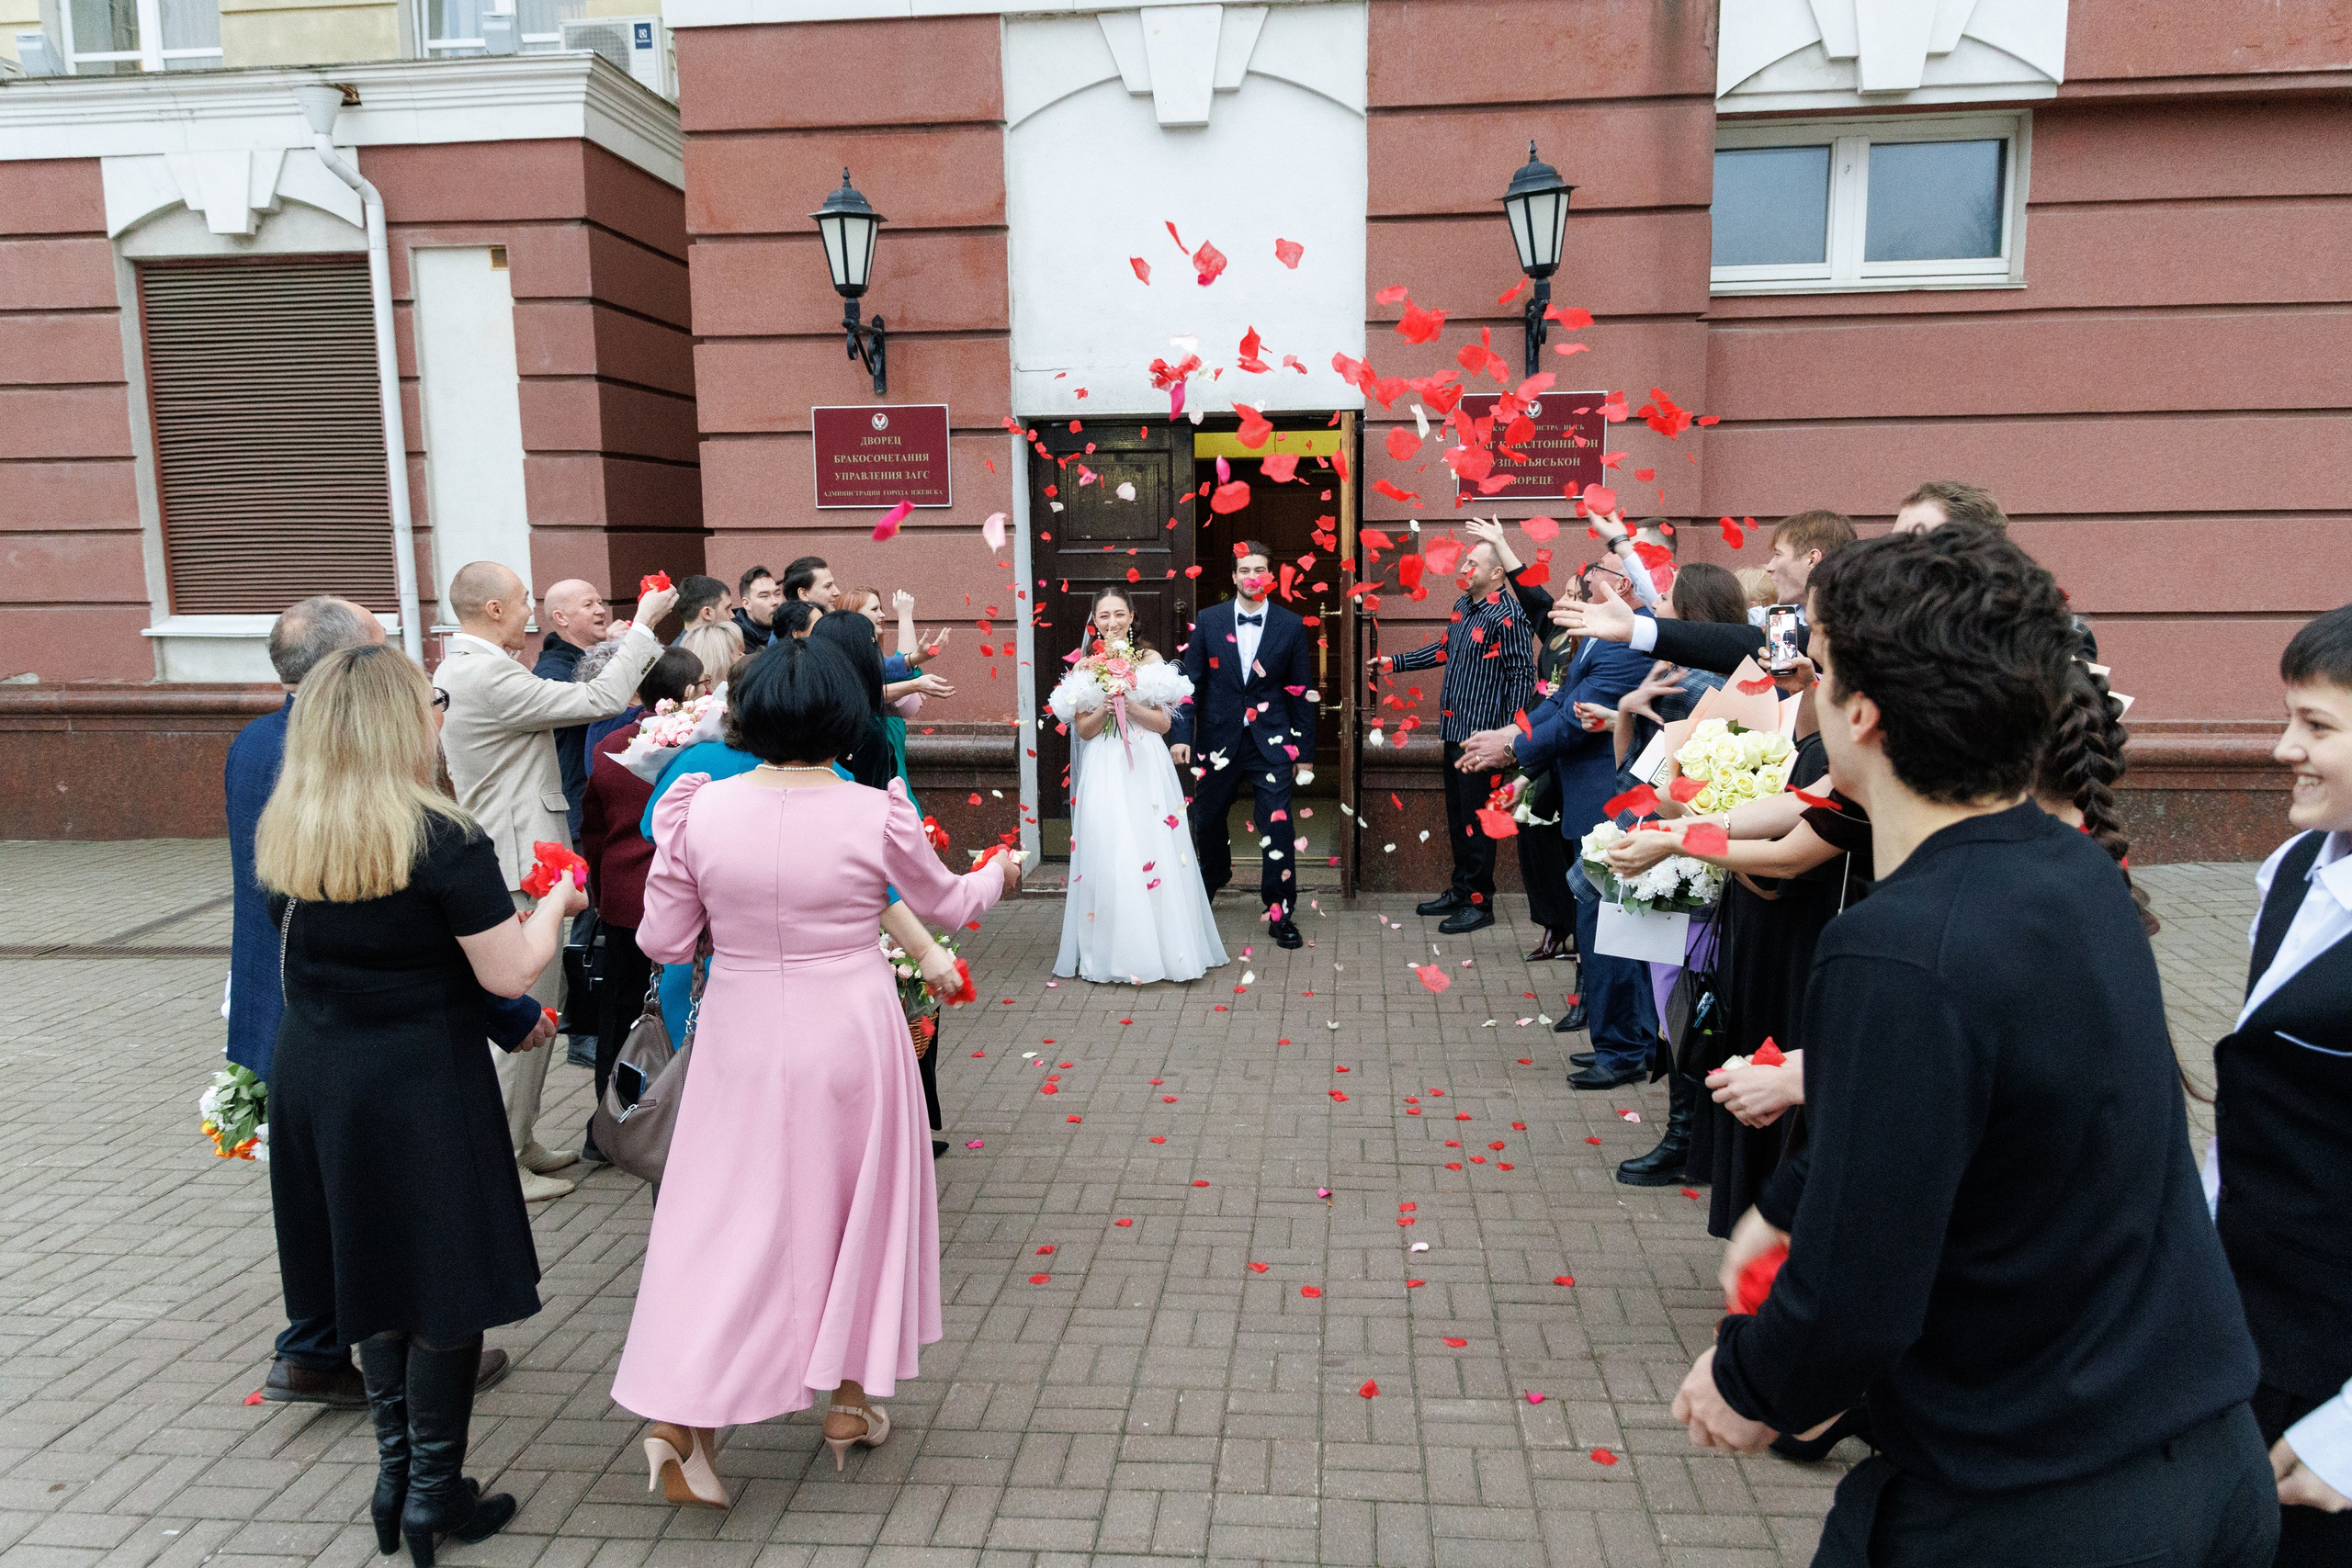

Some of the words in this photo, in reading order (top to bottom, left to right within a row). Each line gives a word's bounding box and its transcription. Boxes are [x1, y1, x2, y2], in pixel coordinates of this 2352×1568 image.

[860, 436, 901, 446] ДВОРЕЦ
[834, 453, 930, 463] БРАКОСОЧЕТАНИЯ
[835, 471, 902, 480] УПРАВЛЕНИЯ
[904, 470, 931, 479] ЗАГС
